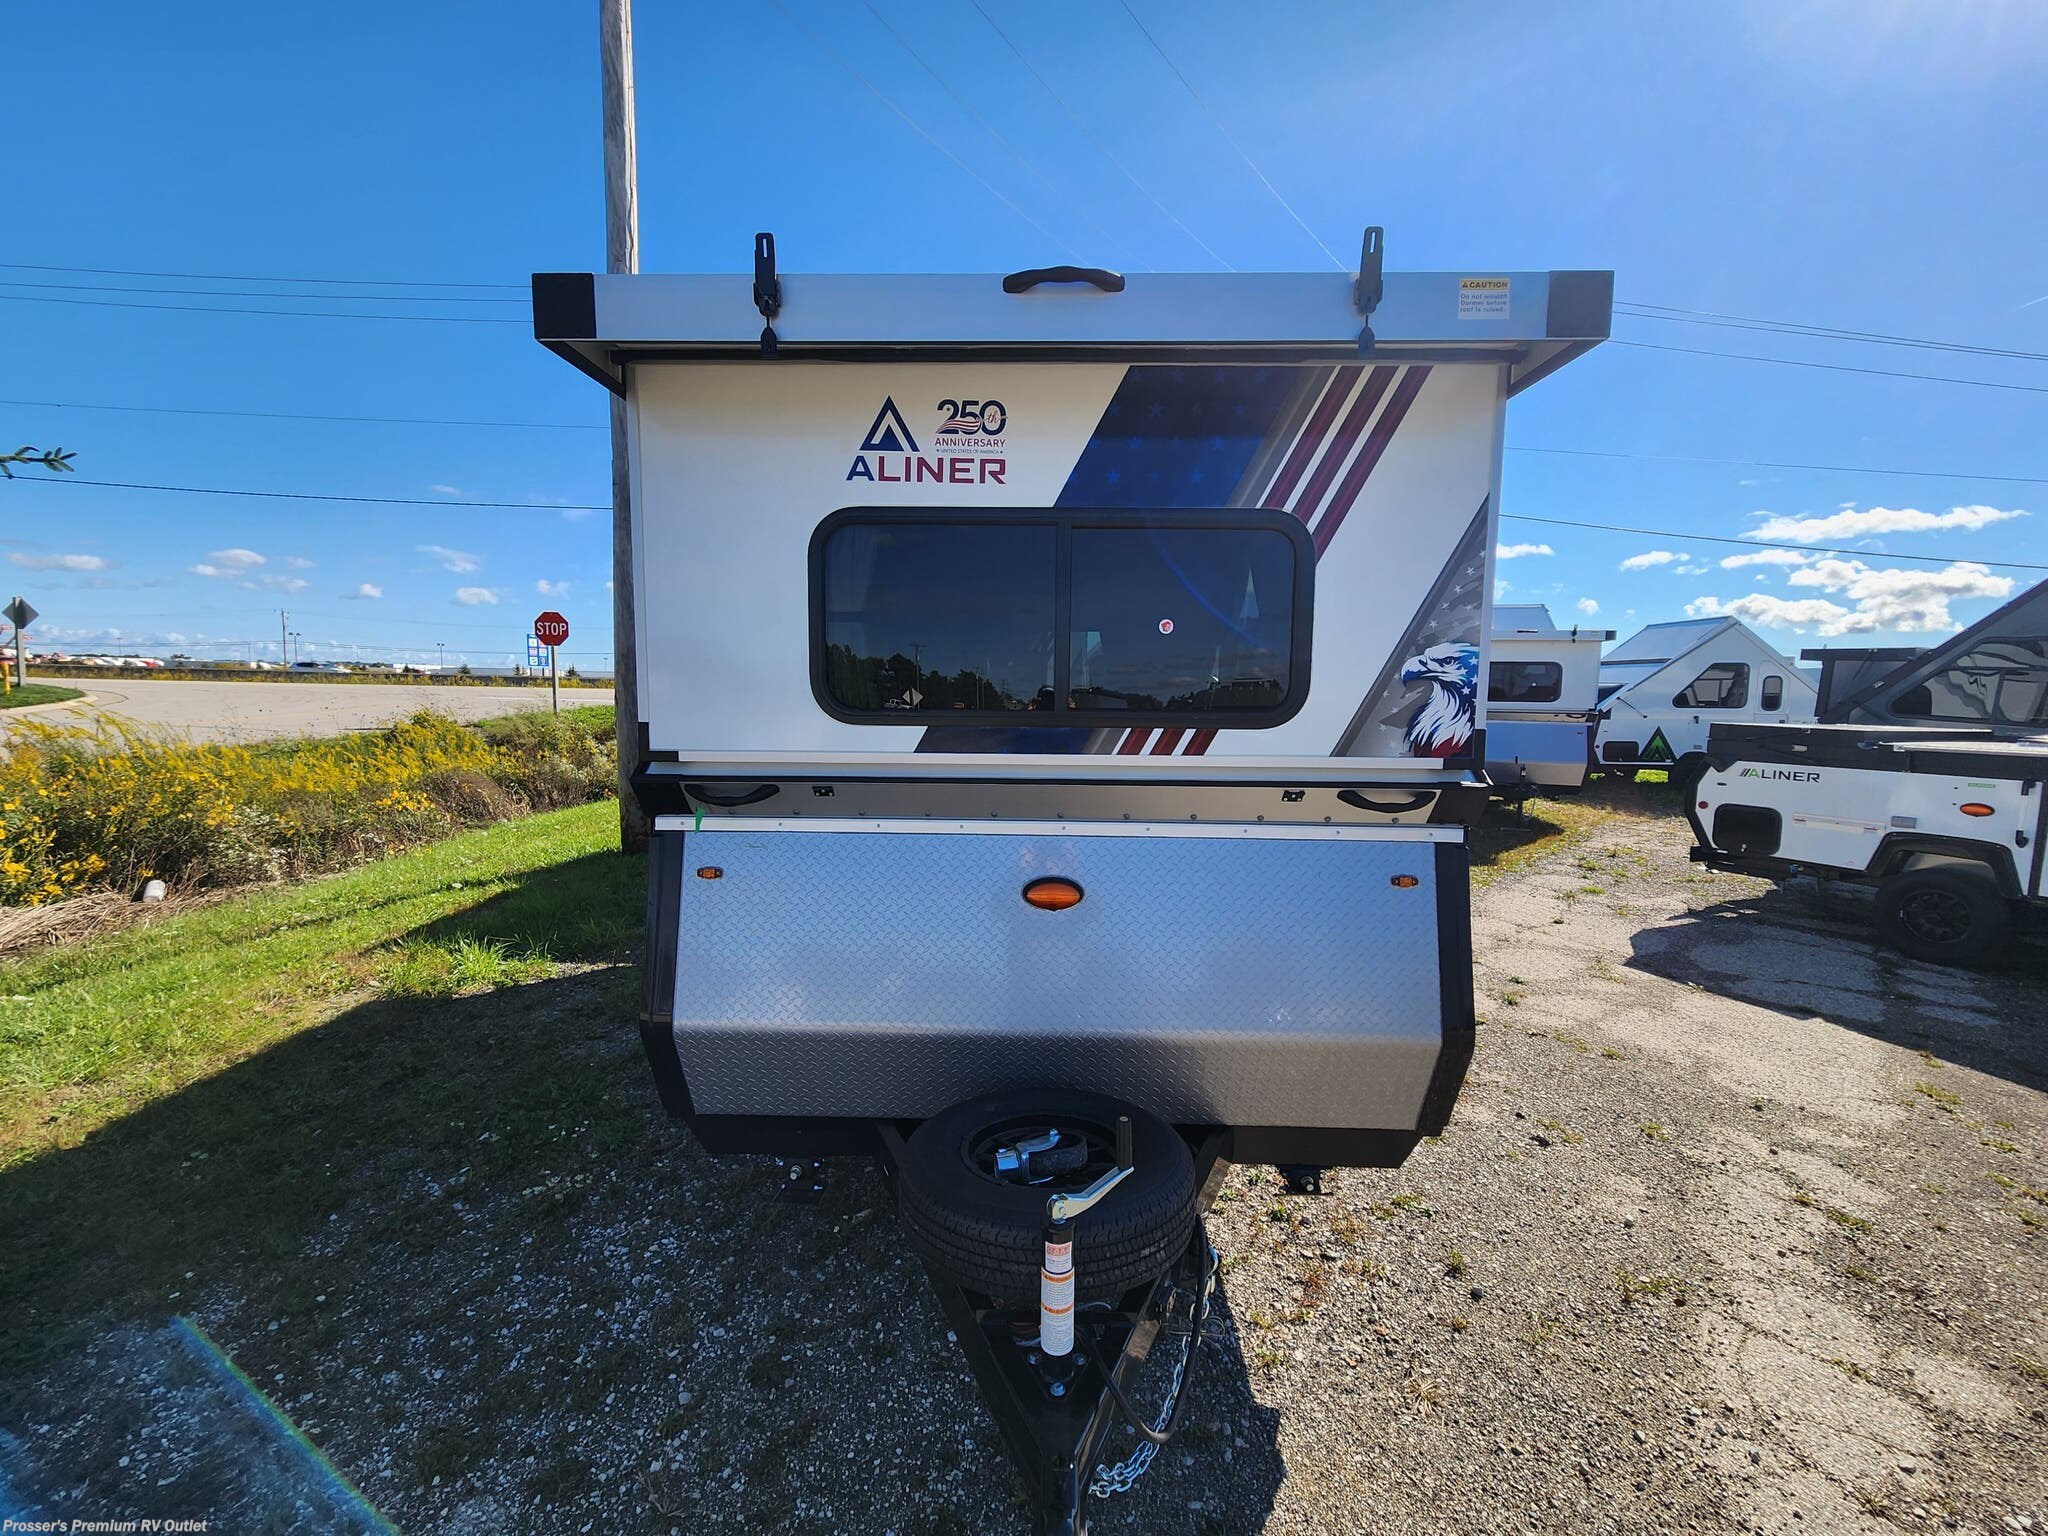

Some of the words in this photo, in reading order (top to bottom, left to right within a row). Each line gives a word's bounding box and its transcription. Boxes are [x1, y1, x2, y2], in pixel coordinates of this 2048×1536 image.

[1469, 281, 1508, 289] CAUTION
[935, 437, 1006, 448] ANNIVERSARY
[846, 455, 1006, 484] ALINER
[536, 622, 567, 636] STOP
[1748, 768, 1820, 783] ALINER
